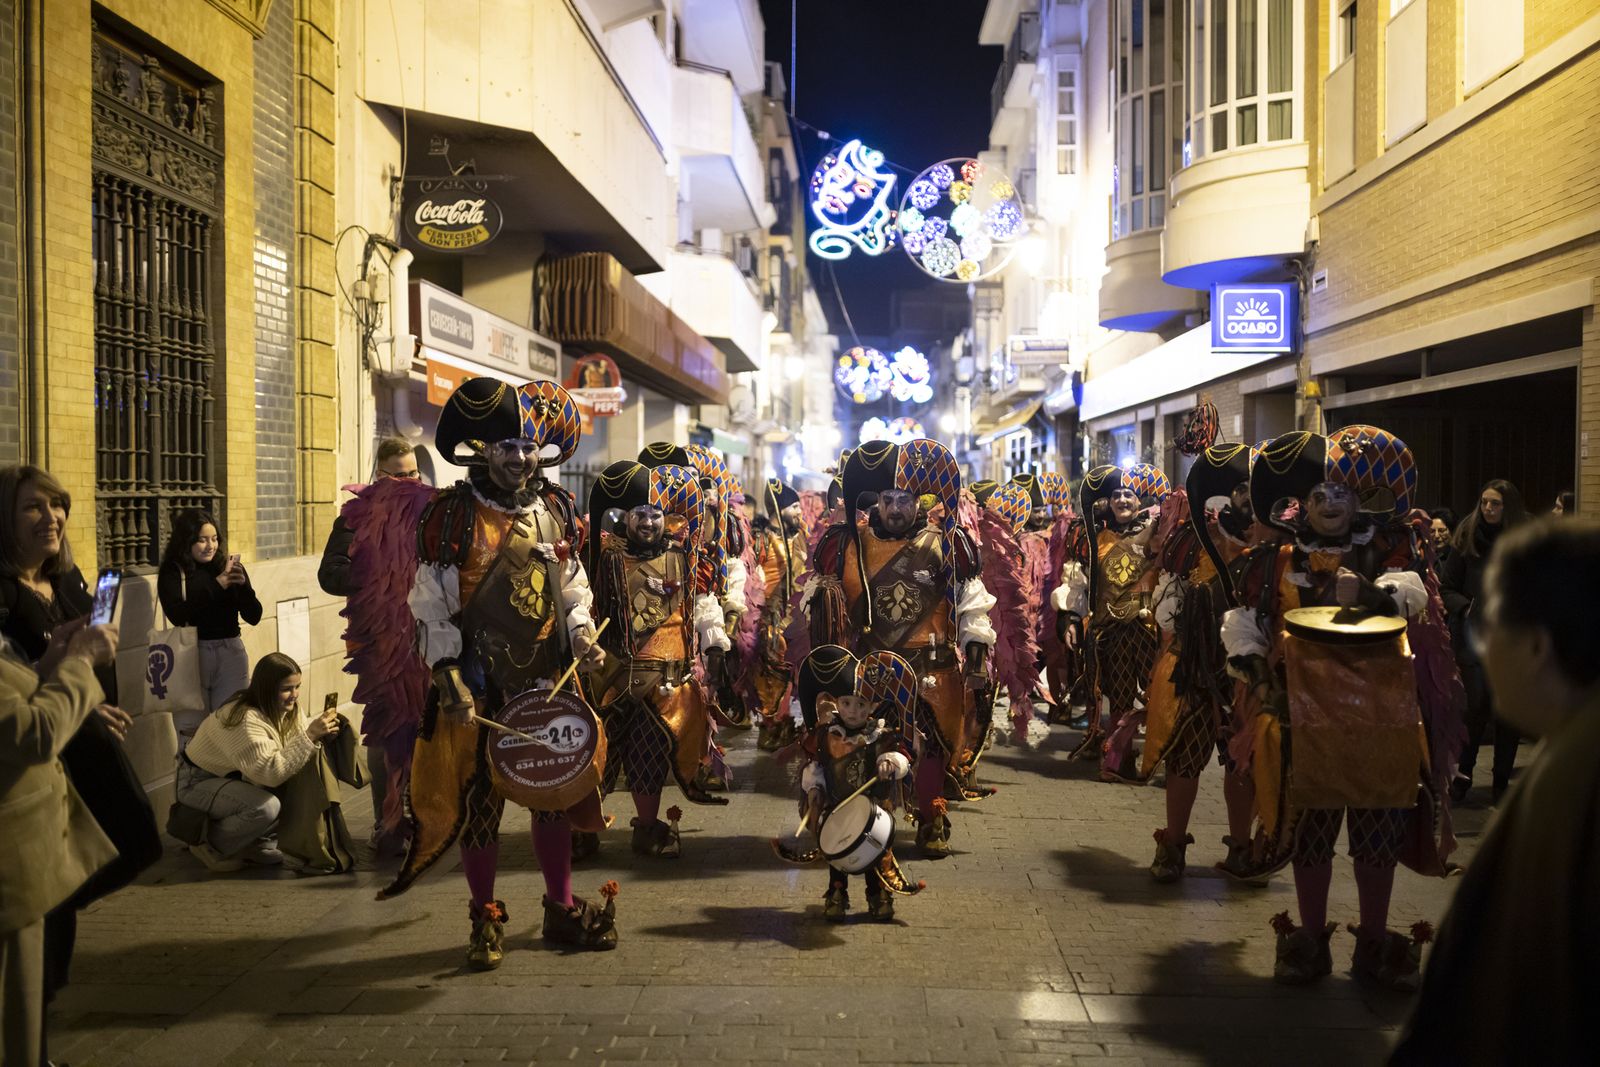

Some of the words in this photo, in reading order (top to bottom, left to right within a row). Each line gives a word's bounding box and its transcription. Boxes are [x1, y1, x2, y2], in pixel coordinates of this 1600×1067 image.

[430, 238, 450, 246] DON
[454, 237, 479, 246] PEPE
[1227, 322, 1278, 334] OCASO
[549, 725, 572, 744] 24
